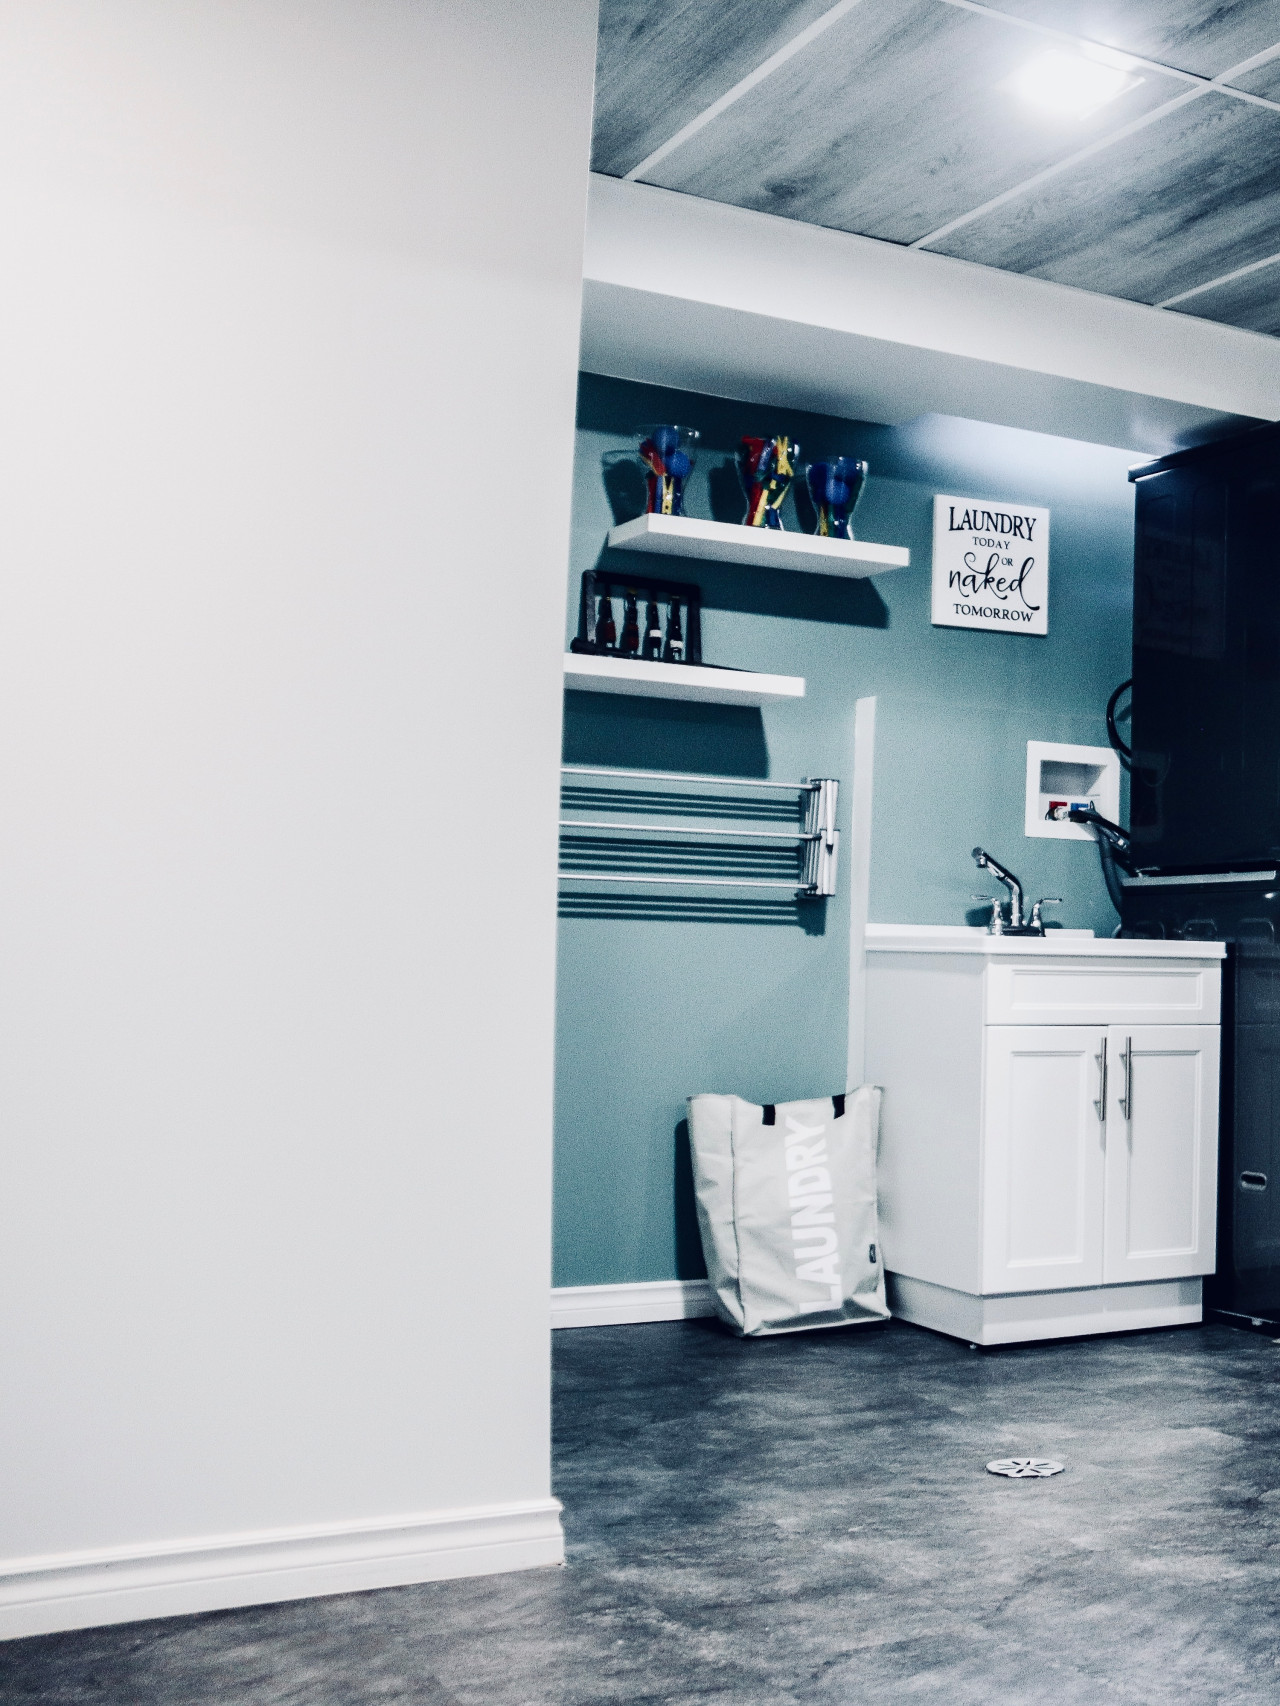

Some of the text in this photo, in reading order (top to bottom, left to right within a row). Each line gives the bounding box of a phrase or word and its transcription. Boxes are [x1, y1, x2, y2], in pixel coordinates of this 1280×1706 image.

[949, 507, 1037, 542] LAUNDRY
[972, 536, 1011, 550] TODAY
[1001, 557, 1013, 567] OR
[949, 552, 1040, 611] naked
[953, 603, 1034, 622] TOMORROW
[784, 1115, 843, 1314] LAUNDRY
